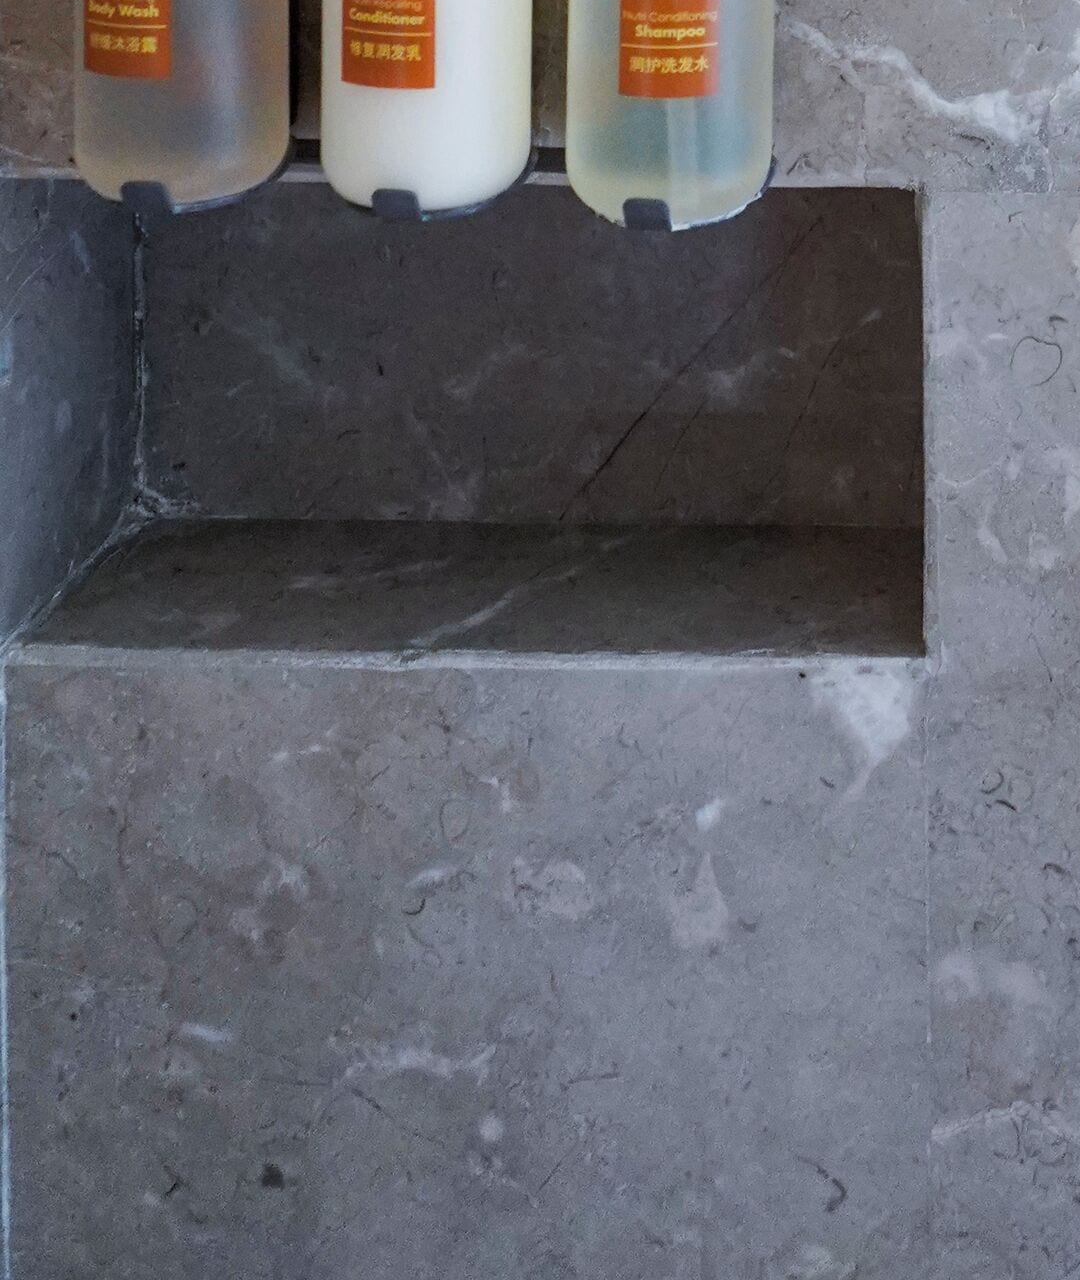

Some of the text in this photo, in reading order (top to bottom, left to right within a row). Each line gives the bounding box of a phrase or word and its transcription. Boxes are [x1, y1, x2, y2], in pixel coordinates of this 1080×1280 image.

[119, 3, 160, 18] Wash
[349, 7, 425, 25] Conditioner
[635, 24, 706, 41] Shampoo
